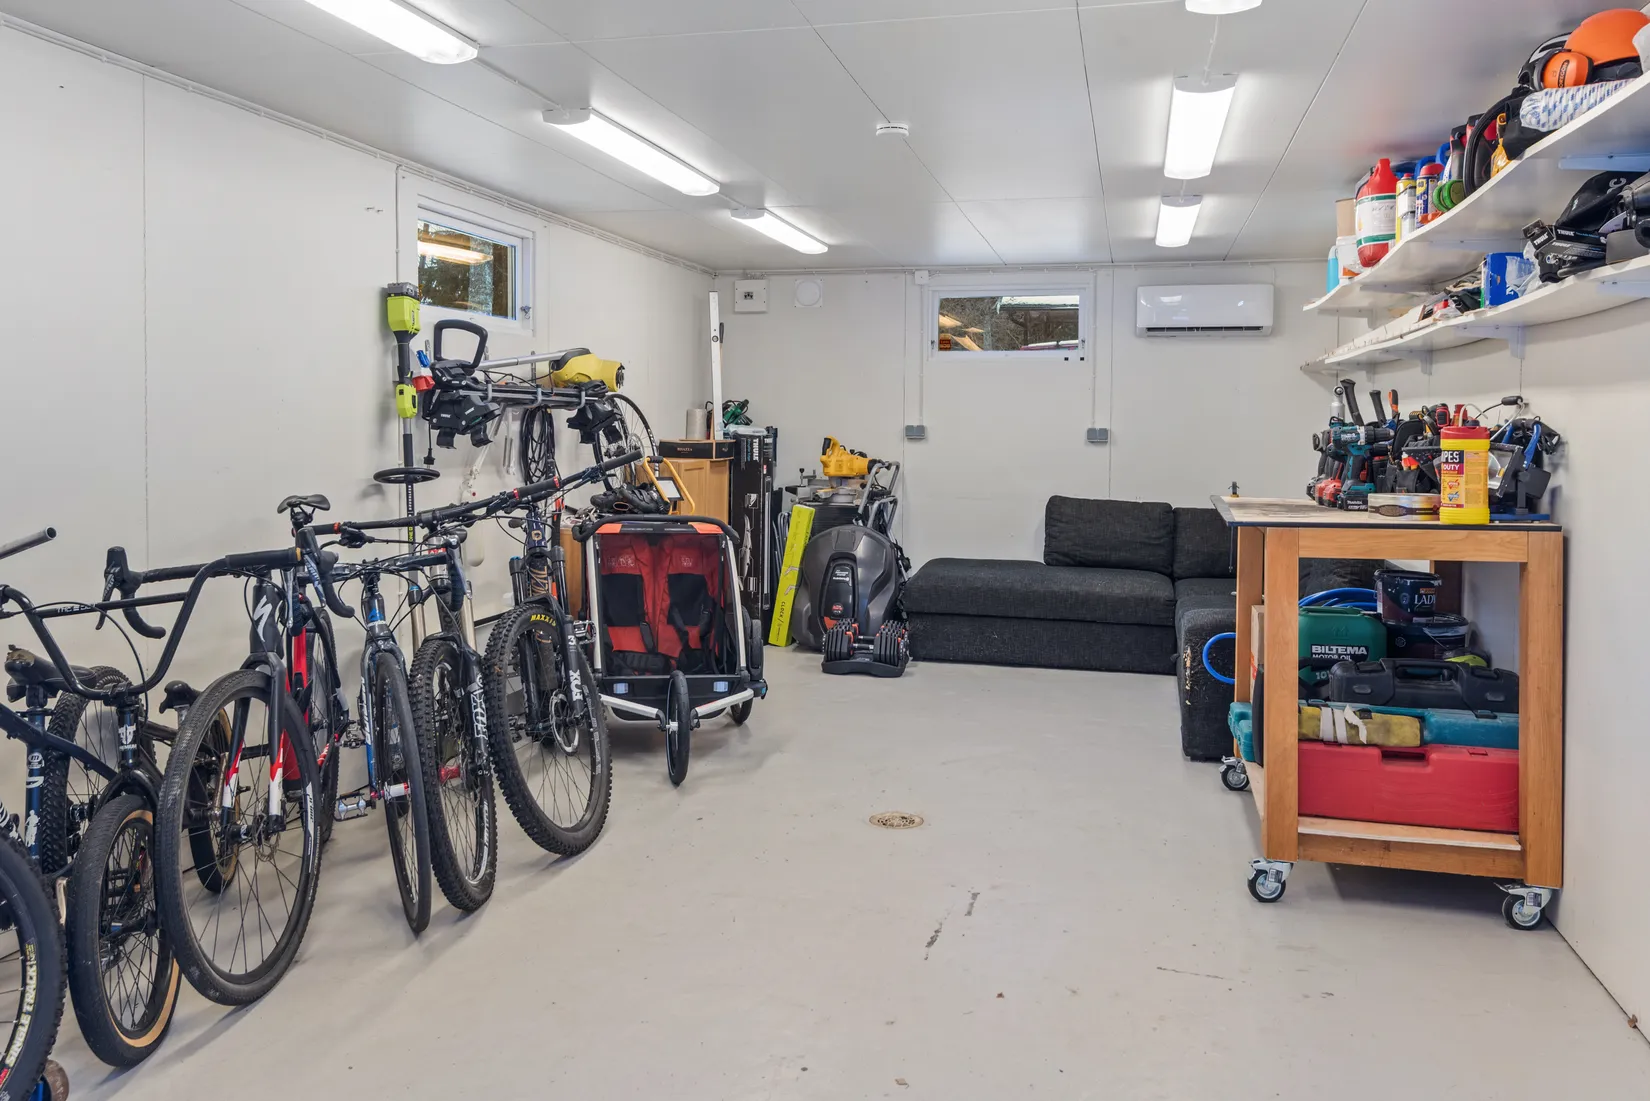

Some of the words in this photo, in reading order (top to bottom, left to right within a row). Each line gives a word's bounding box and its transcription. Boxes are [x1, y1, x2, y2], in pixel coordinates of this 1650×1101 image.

[1533, 232, 1549, 246] THULE
[530, 613, 557, 627] MAXXIS
[1311, 645, 1368, 655] BILTEMA
[1315, 672, 1330, 680] 10
[569, 669, 583, 701] FOX
[470, 692, 489, 741] FOX
[5, 1014, 31, 1068] SINGLE
[22, 964, 37, 1013] TRACK
